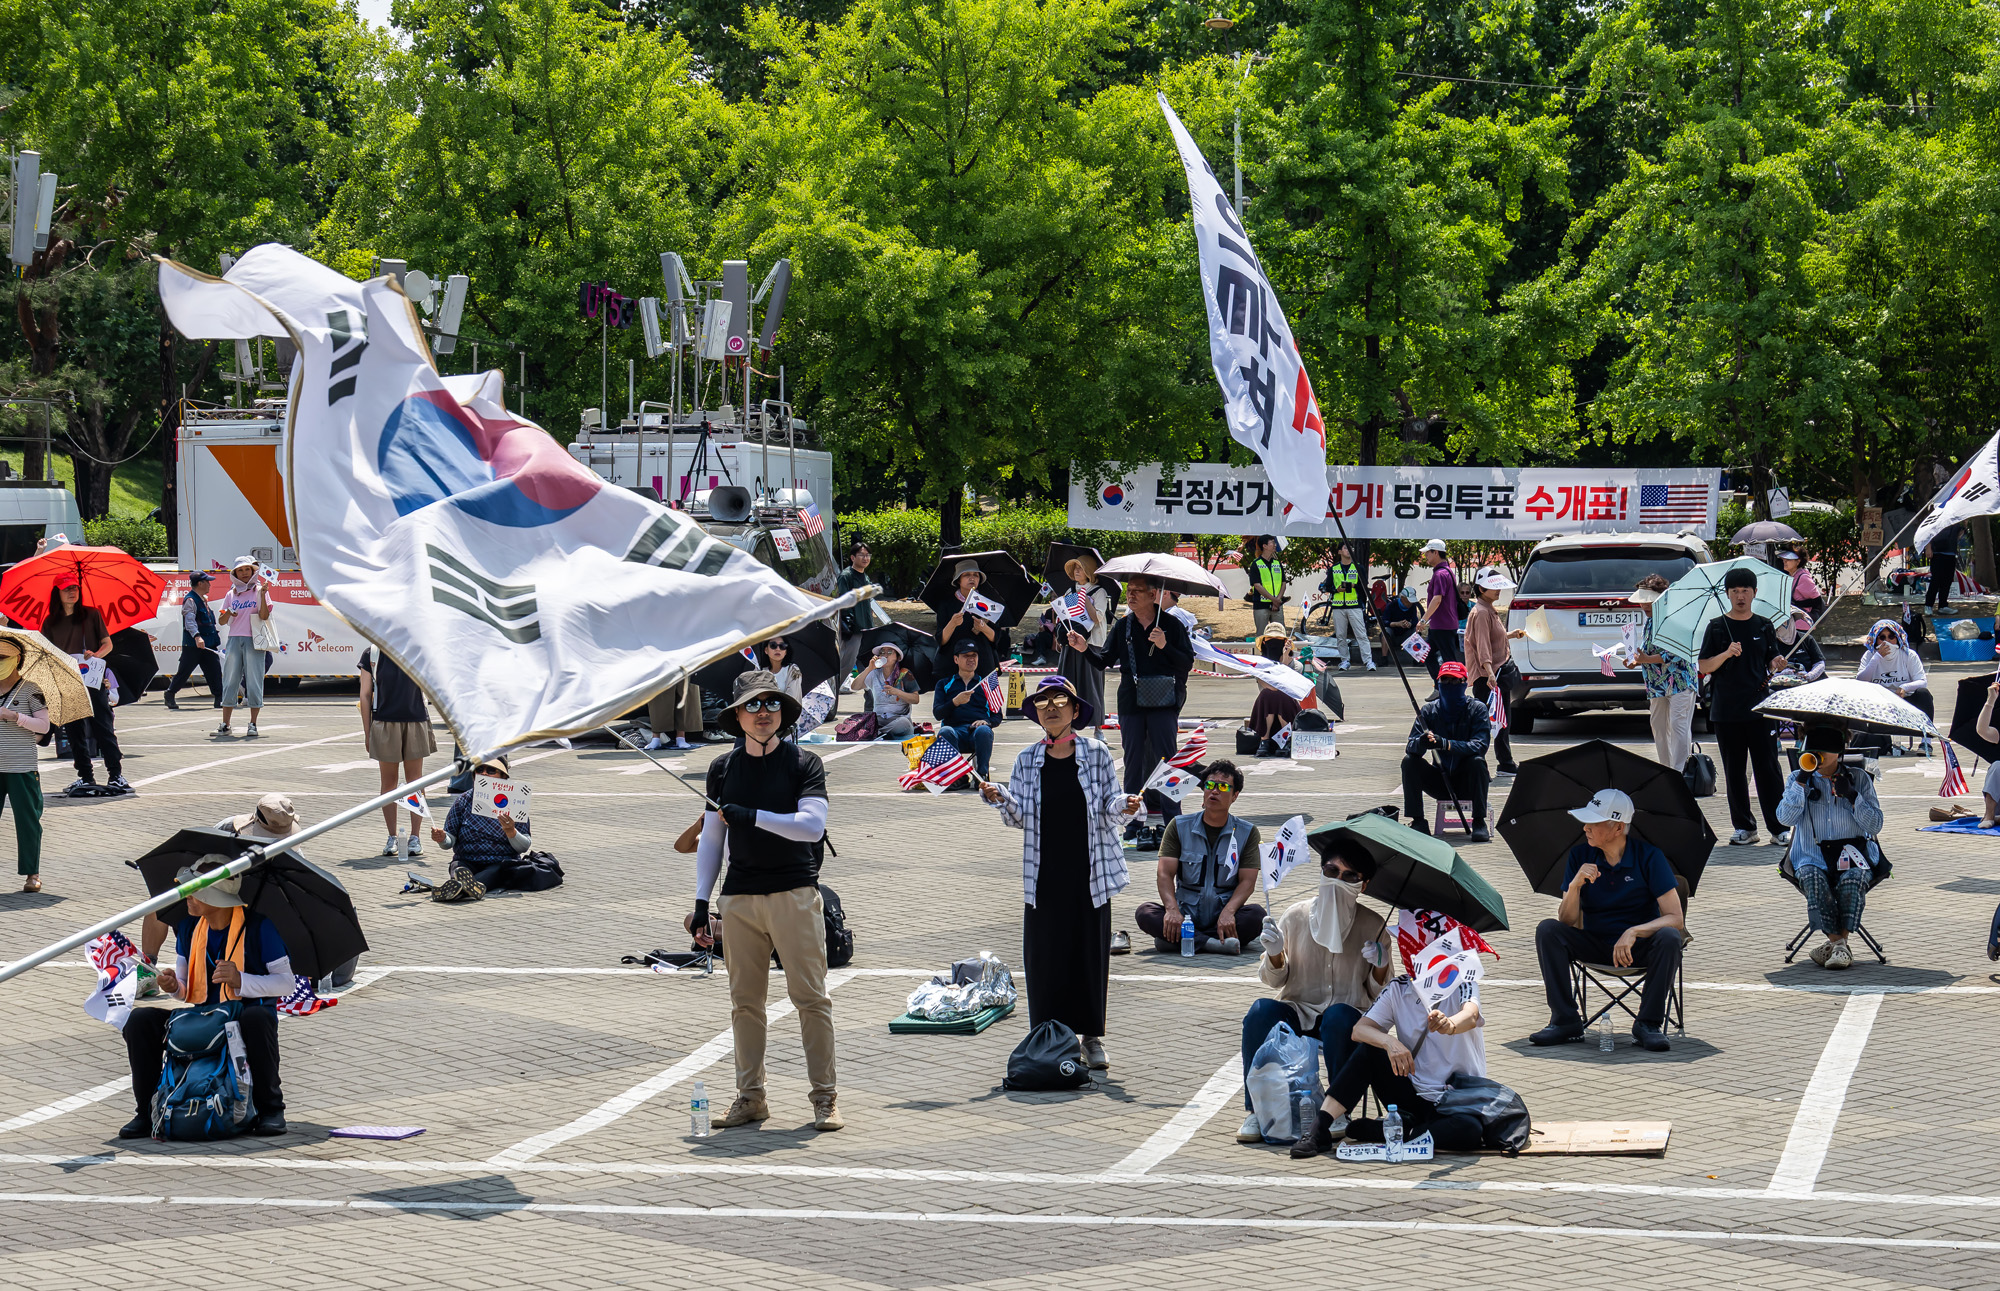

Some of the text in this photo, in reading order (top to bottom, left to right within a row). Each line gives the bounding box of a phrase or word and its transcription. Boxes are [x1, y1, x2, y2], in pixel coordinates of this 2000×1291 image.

[1155, 478, 1274, 516] 부정선거
[1394, 484, 1514, 520] 당일투표
[1525, 486, 1628, 521] 수개표!
[1587, 613, 1638, 623] 175하 5211
[298, 642, 353, 652] SK telecom
[1339, 1148, 1380, 1157] 당일투표
